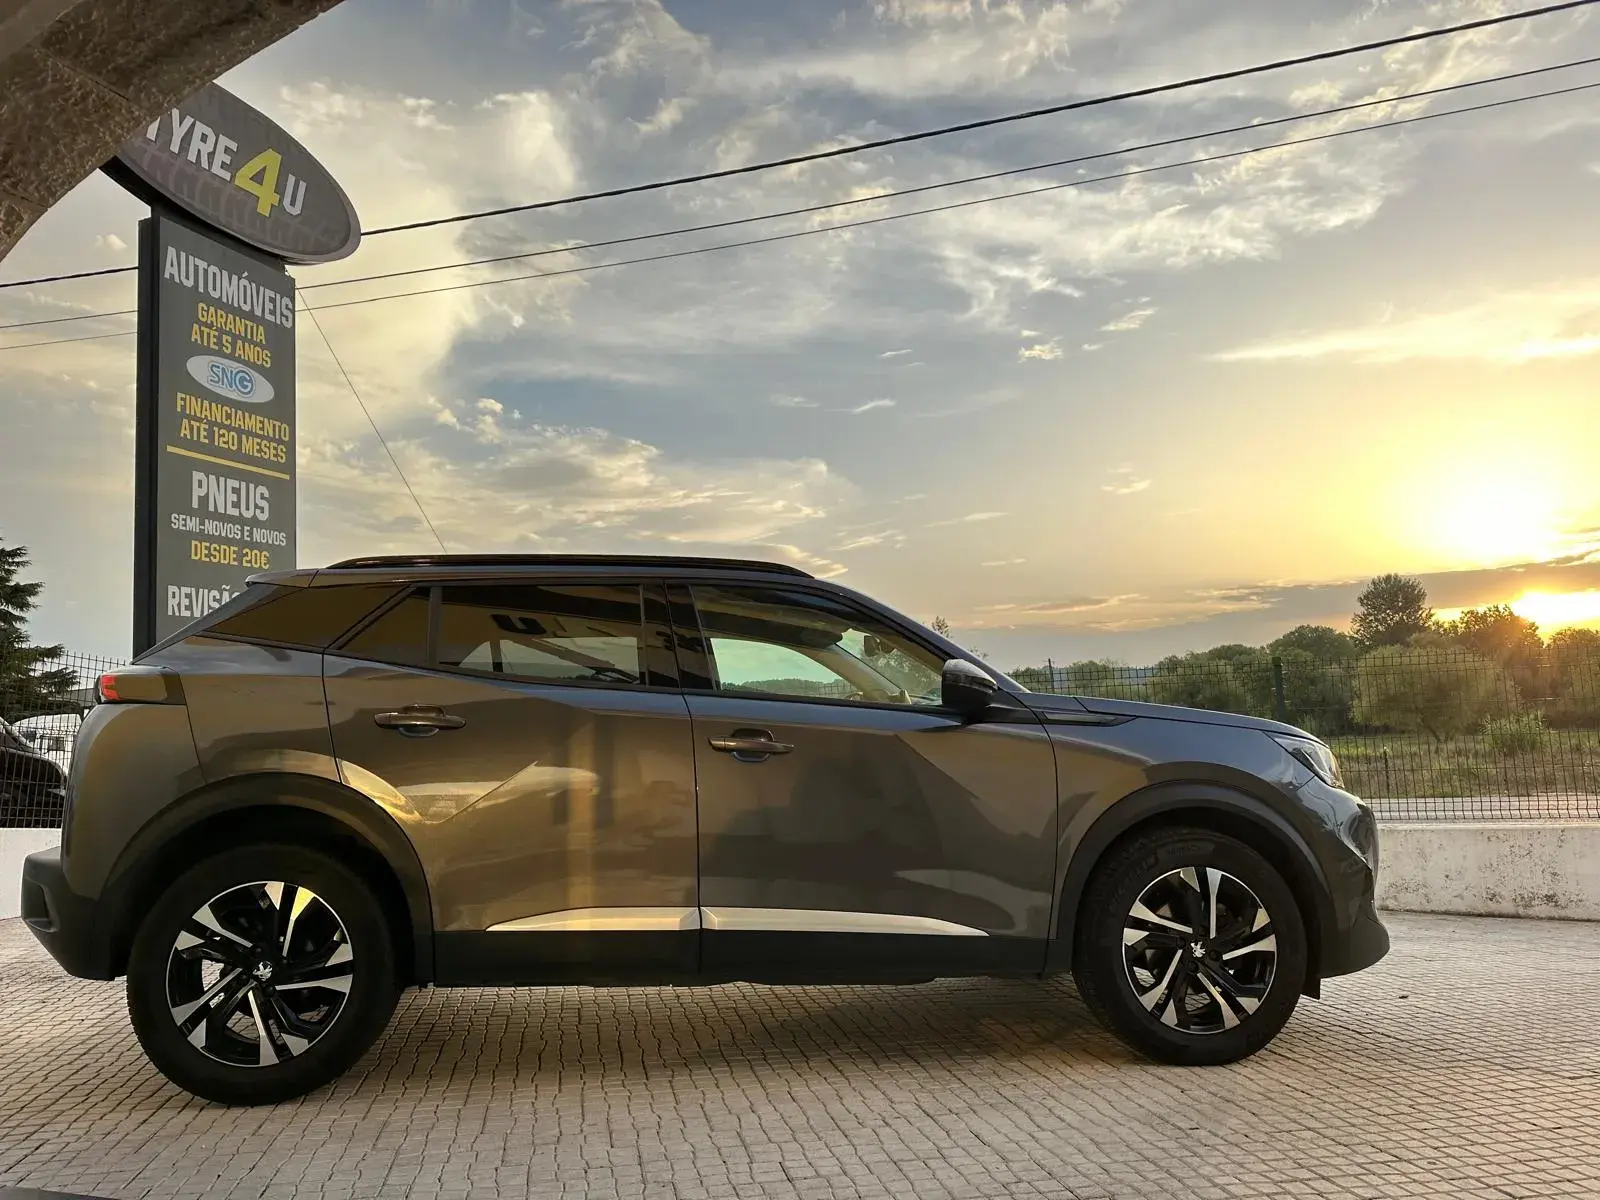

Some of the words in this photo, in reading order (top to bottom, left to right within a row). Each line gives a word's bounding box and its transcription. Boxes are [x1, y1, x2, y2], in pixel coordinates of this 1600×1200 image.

[164, 246, 293, 328] AUTOMÓVEIS
[197, 303, 266, 344] GARANTIA
[191, 323, 219, 350] ATÉ
[222, 333, 232, 354] 5
[235, 341, 271, 368] ANOS
[208, 362, 255, 397] SNG
[176, 392, 290, 441] FINANCIAMENTO
[180, 418, 209, 443] ATÉ
[213, 426, 238, 450] 120
[241, 435, 286, 463] MESES
[191, 470, 270, 521] PNEUS
[171, 513, 241, 540] SEMI-NOVOS
[244, 526, 251, 541] E
[252, 528, 286, 546] NOVOS
[191, 540, 238, 566] DESDE
[242, 549, 270, 569] 20€
[167, 584, 241, 618] REVISÃ
